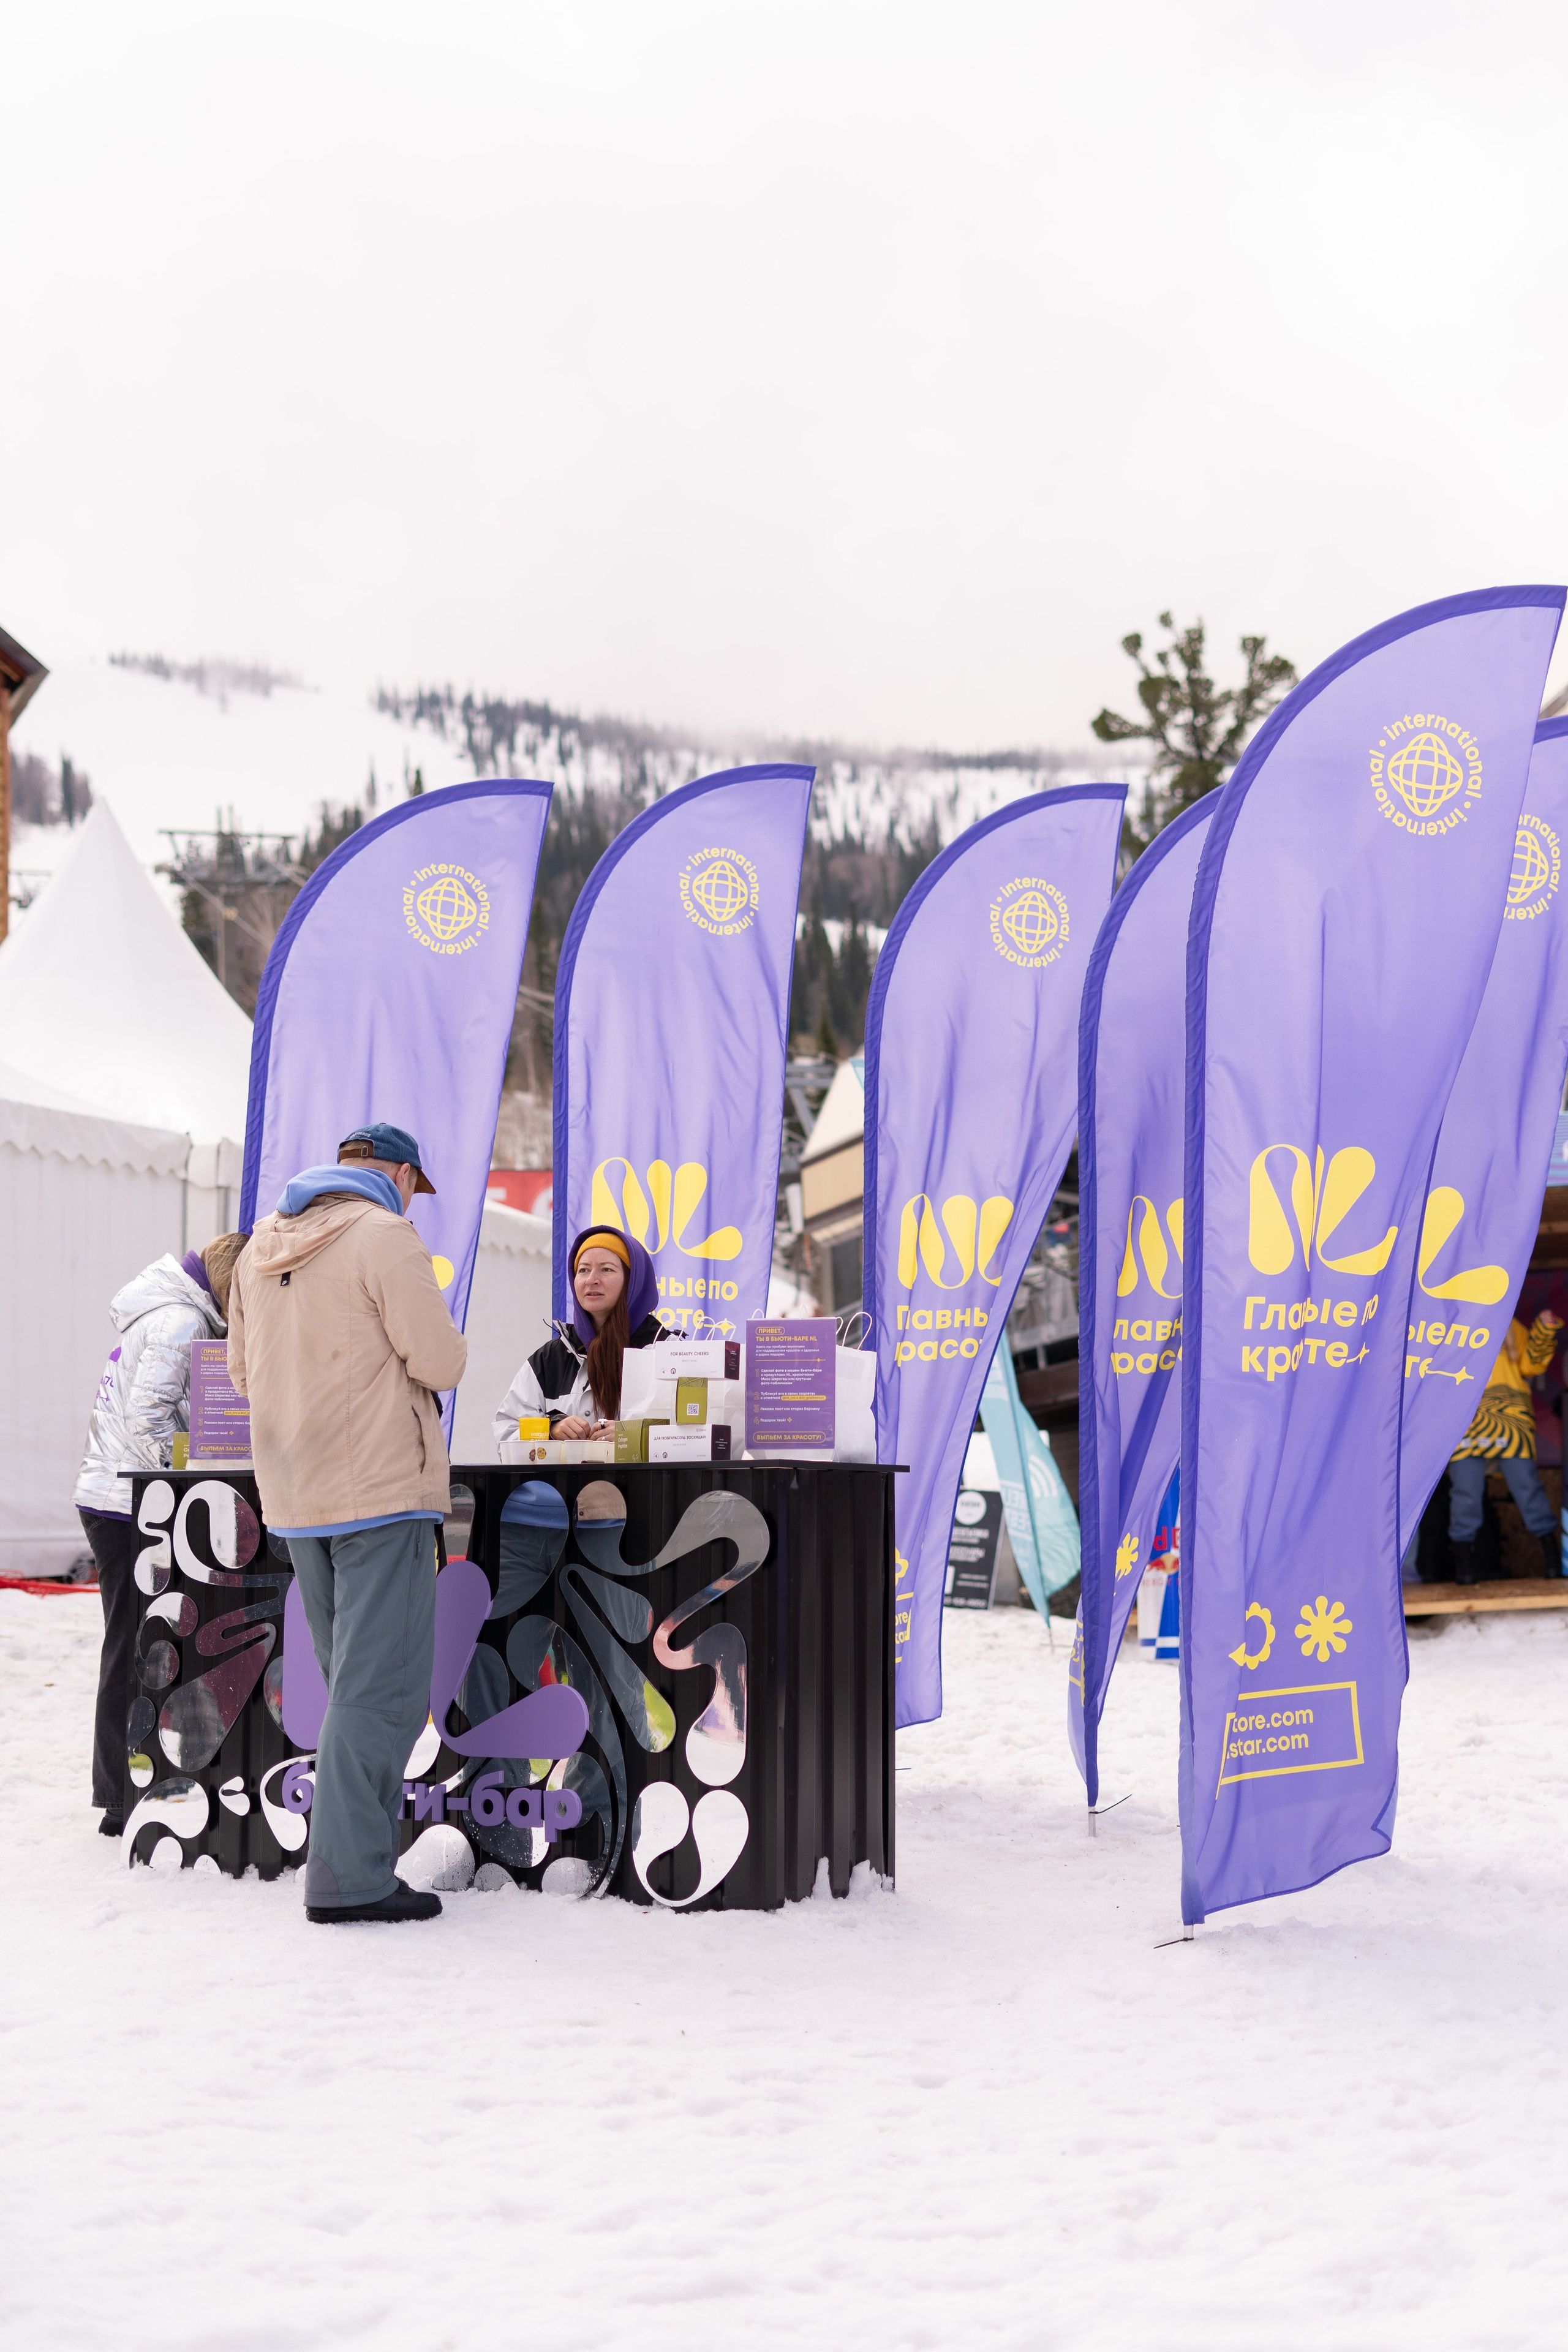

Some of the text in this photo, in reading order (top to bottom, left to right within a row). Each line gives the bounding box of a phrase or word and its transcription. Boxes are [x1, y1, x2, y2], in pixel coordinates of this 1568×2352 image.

[1383, 714, 1482, 799] international
[1370, 750, 1468, 835] international
[413, 863, 491, 930] international
[679, 872, 753, 935] international
[688, 847, 760, 911] international
[999, 877, 1069, 941] international
[402, 887, 478, 955] international
[989, 903, 1061, 968] international
